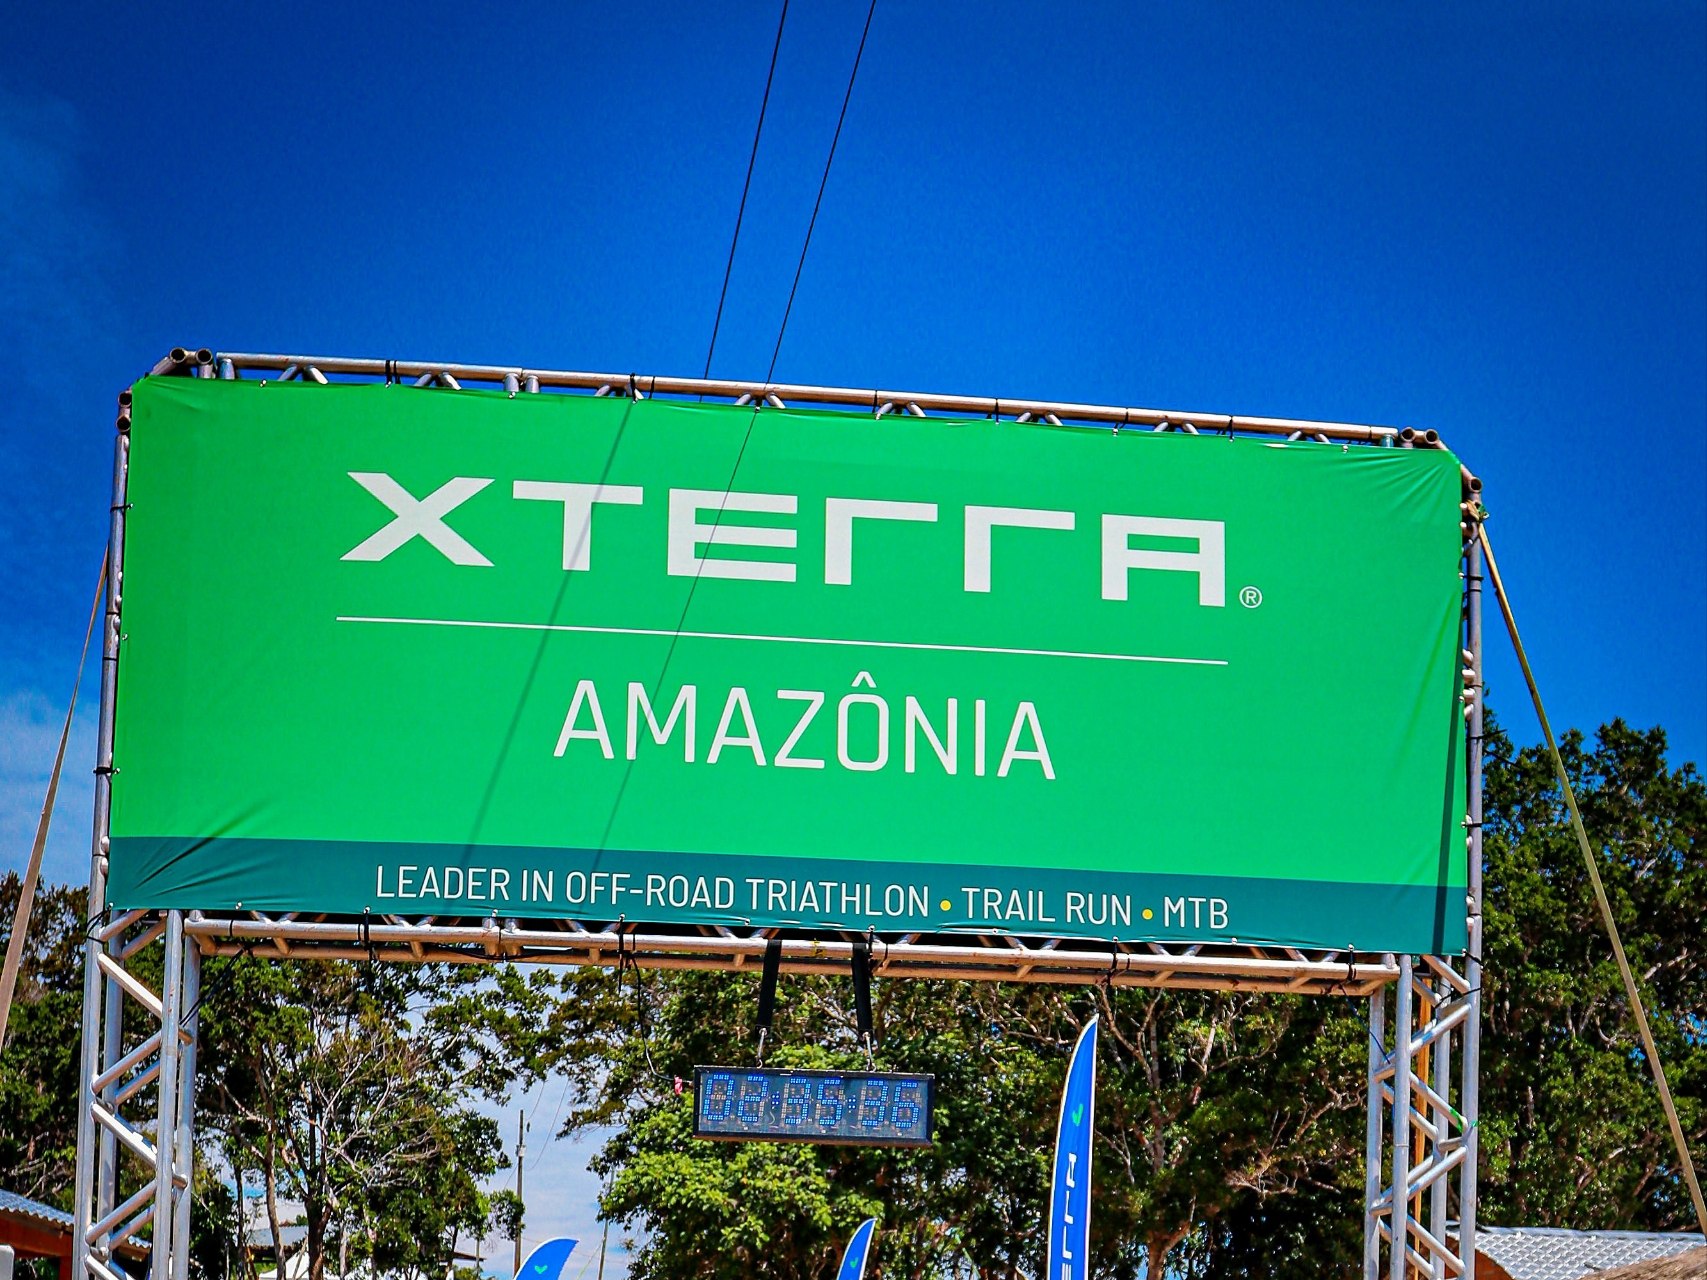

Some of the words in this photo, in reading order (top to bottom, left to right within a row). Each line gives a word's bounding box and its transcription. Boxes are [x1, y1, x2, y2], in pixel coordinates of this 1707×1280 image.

[339, 470, 1226, 608] XTERRA
[553, 670, 1057, 781] AMAZÔNIA
[375, 864, 510, 901] LEADER
[521, 869, 557, 902] IN
[565, 870, 736, 909] OFF-ROAD
[745, 877, 929, 917] TRIATHLON
[961, 886, 1056, 923] TRAIL
[1066, 891, 1132, 926] RUN
[1163, 896, 1229, 930] MTB
[703, 1073, 920, 1128] 02:35:36
